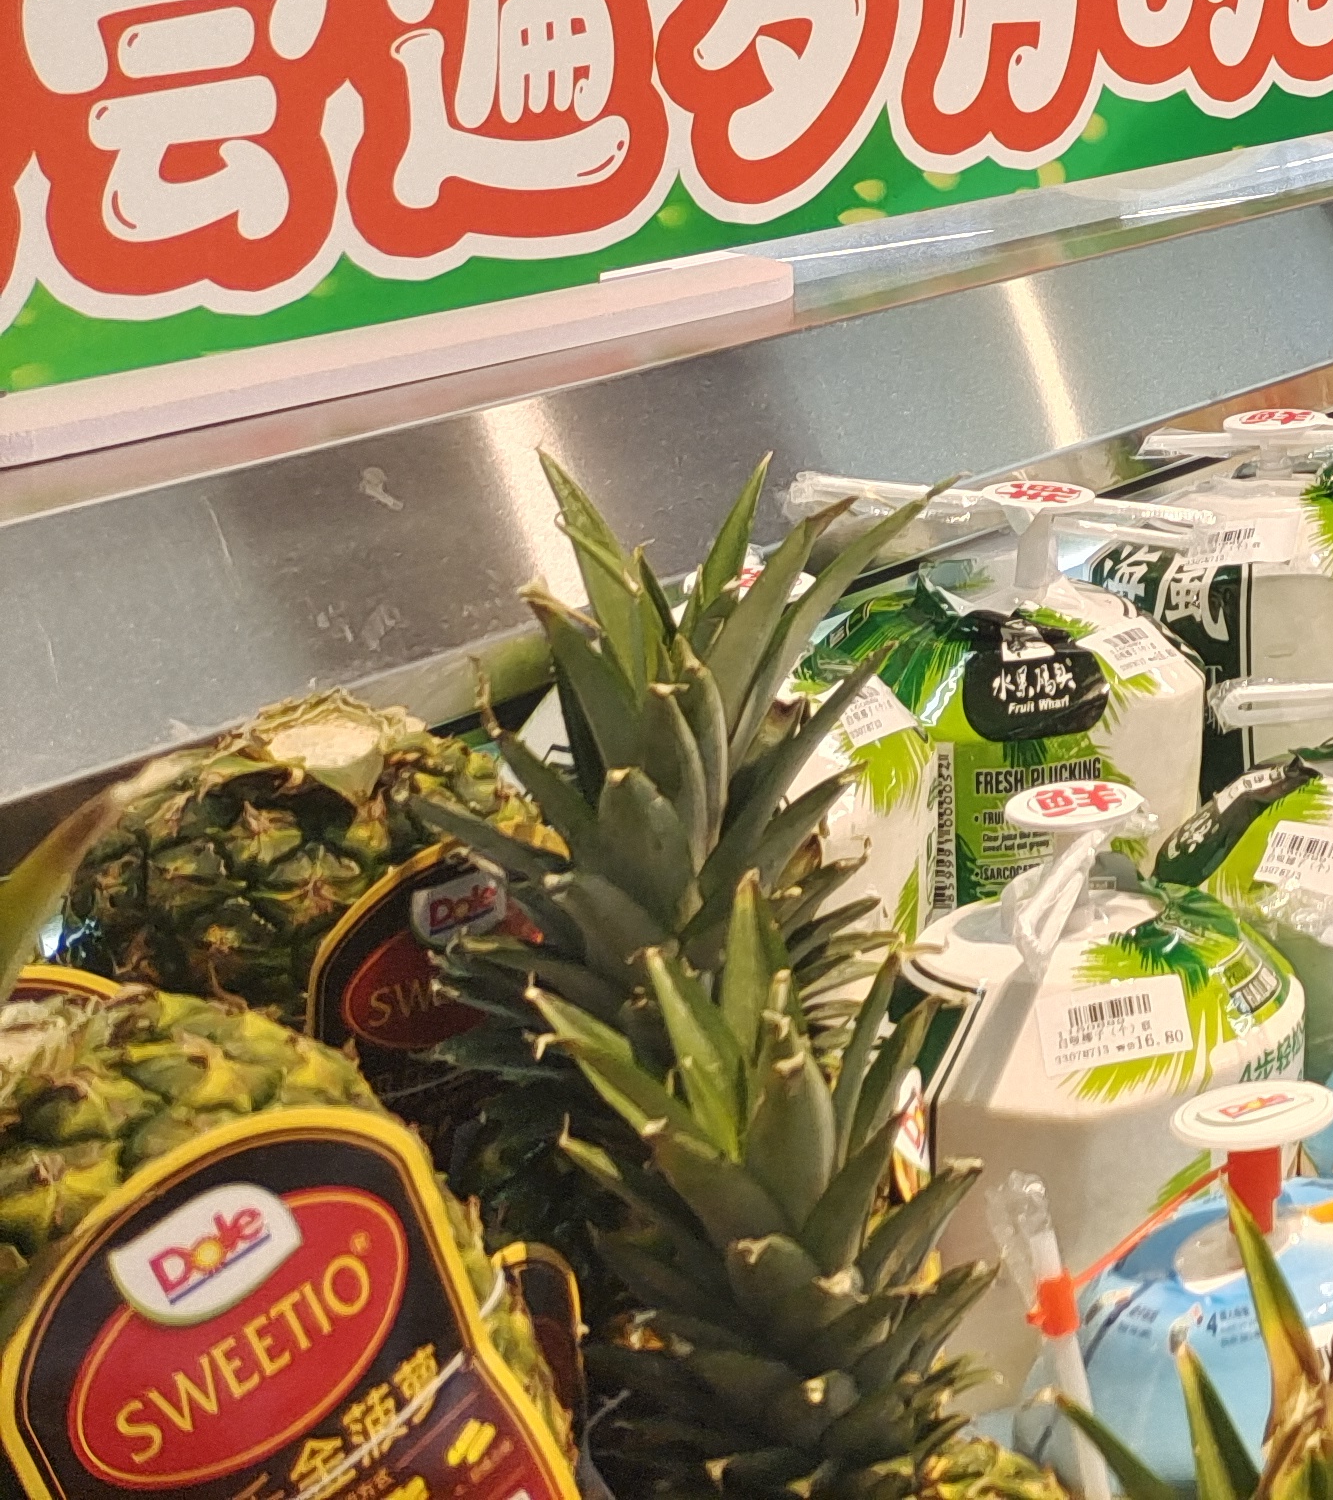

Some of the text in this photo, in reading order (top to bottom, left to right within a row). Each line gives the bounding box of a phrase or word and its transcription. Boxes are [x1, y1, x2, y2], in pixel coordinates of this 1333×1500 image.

[1008, 696, 1070, 715] Fruit Wharf
[975, 767, 1025, 795] FRESH
[150, 1203, 268, 1298] Dole
[115, 1255, 372, 1465] SWEETIO
